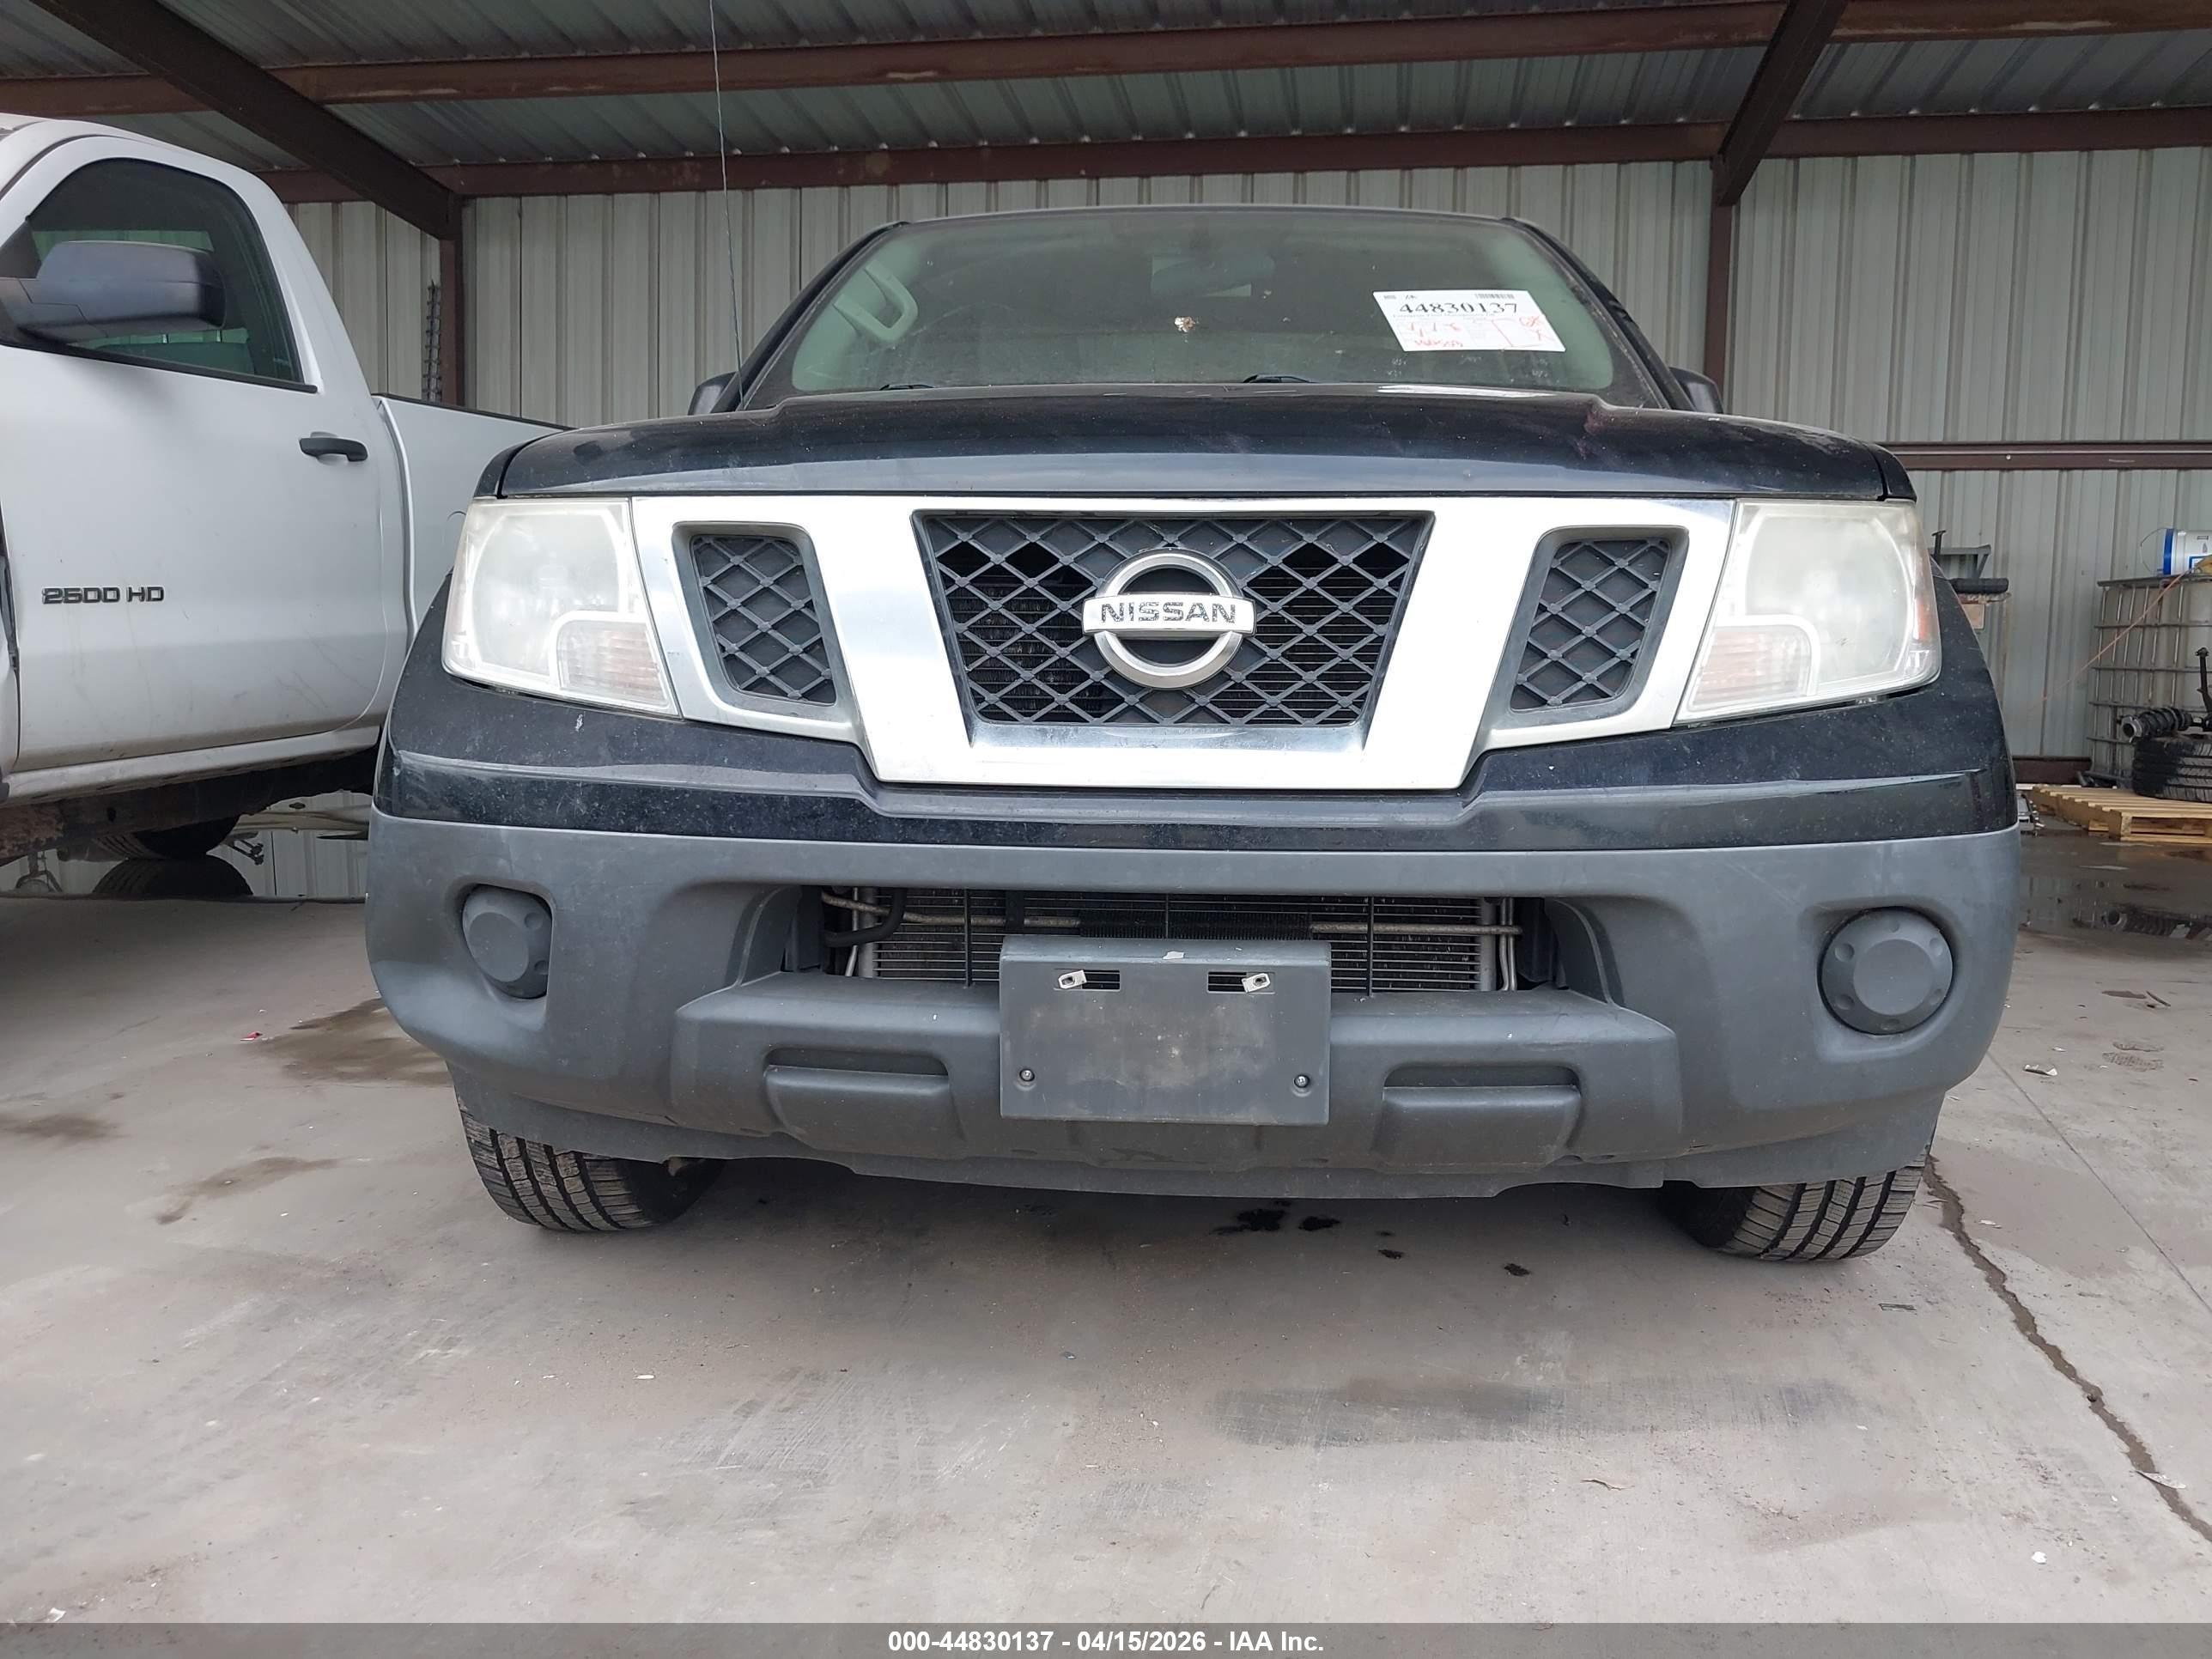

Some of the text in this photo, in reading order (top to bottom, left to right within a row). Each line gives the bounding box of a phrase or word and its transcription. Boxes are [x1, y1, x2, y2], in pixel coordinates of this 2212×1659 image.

[1399, 302, 1517, 314] 44830137
[42, 586, 165, 604] 2500 HD
[1101, 602, 1236, 623] NISSAN
